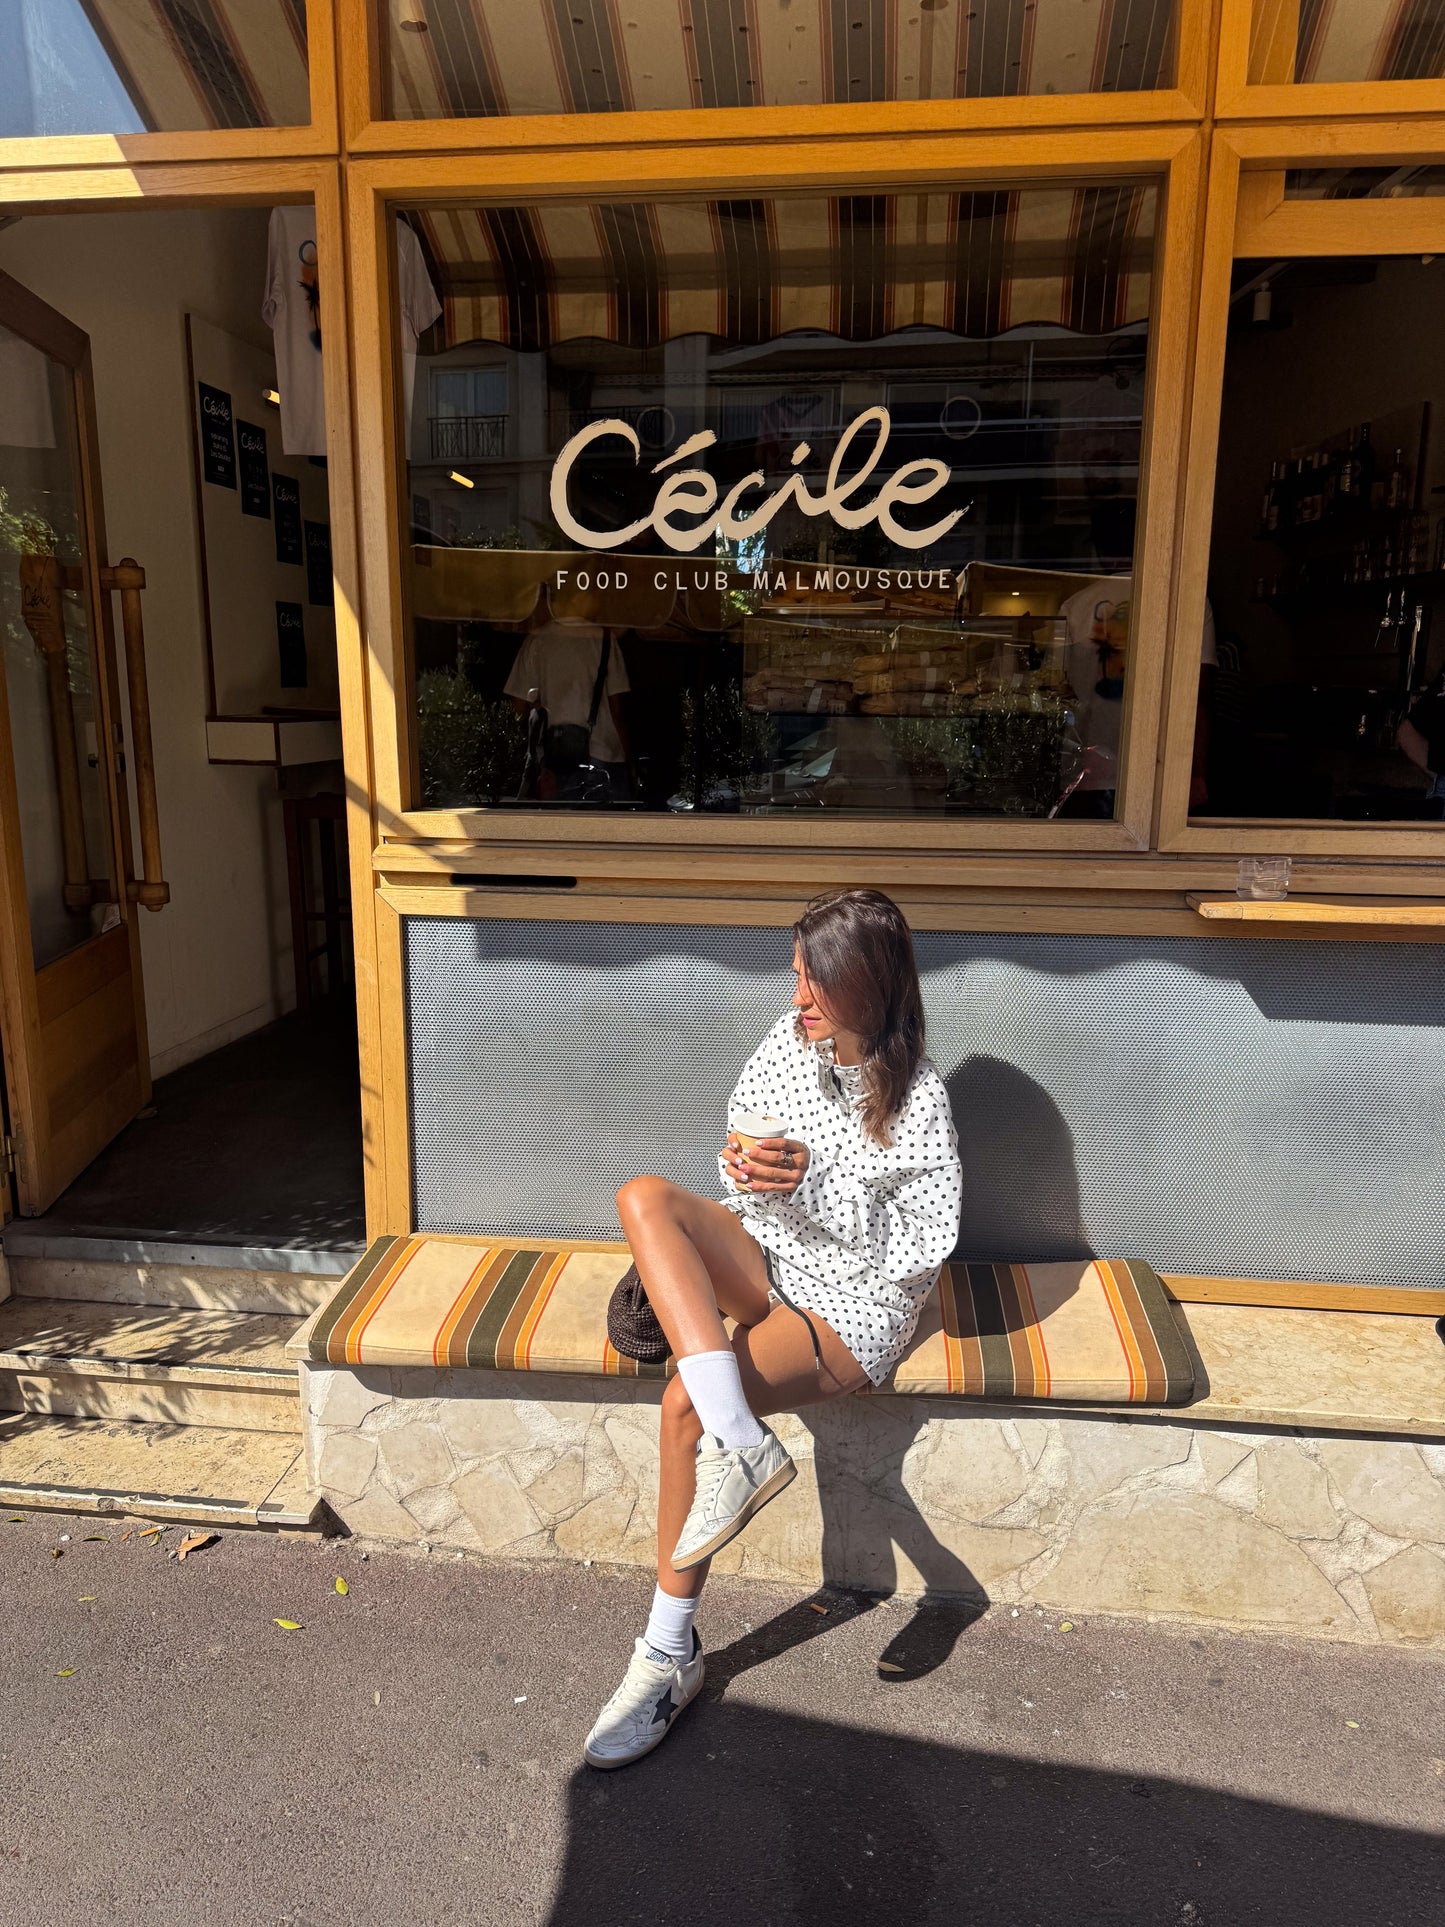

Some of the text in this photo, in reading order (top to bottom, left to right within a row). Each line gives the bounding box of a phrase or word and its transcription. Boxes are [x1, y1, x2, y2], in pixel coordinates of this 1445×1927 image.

[549, 405, 974, 552] Cécile
[556, 569, 951, 591] FOOD CLUB MALMOUSQUE
